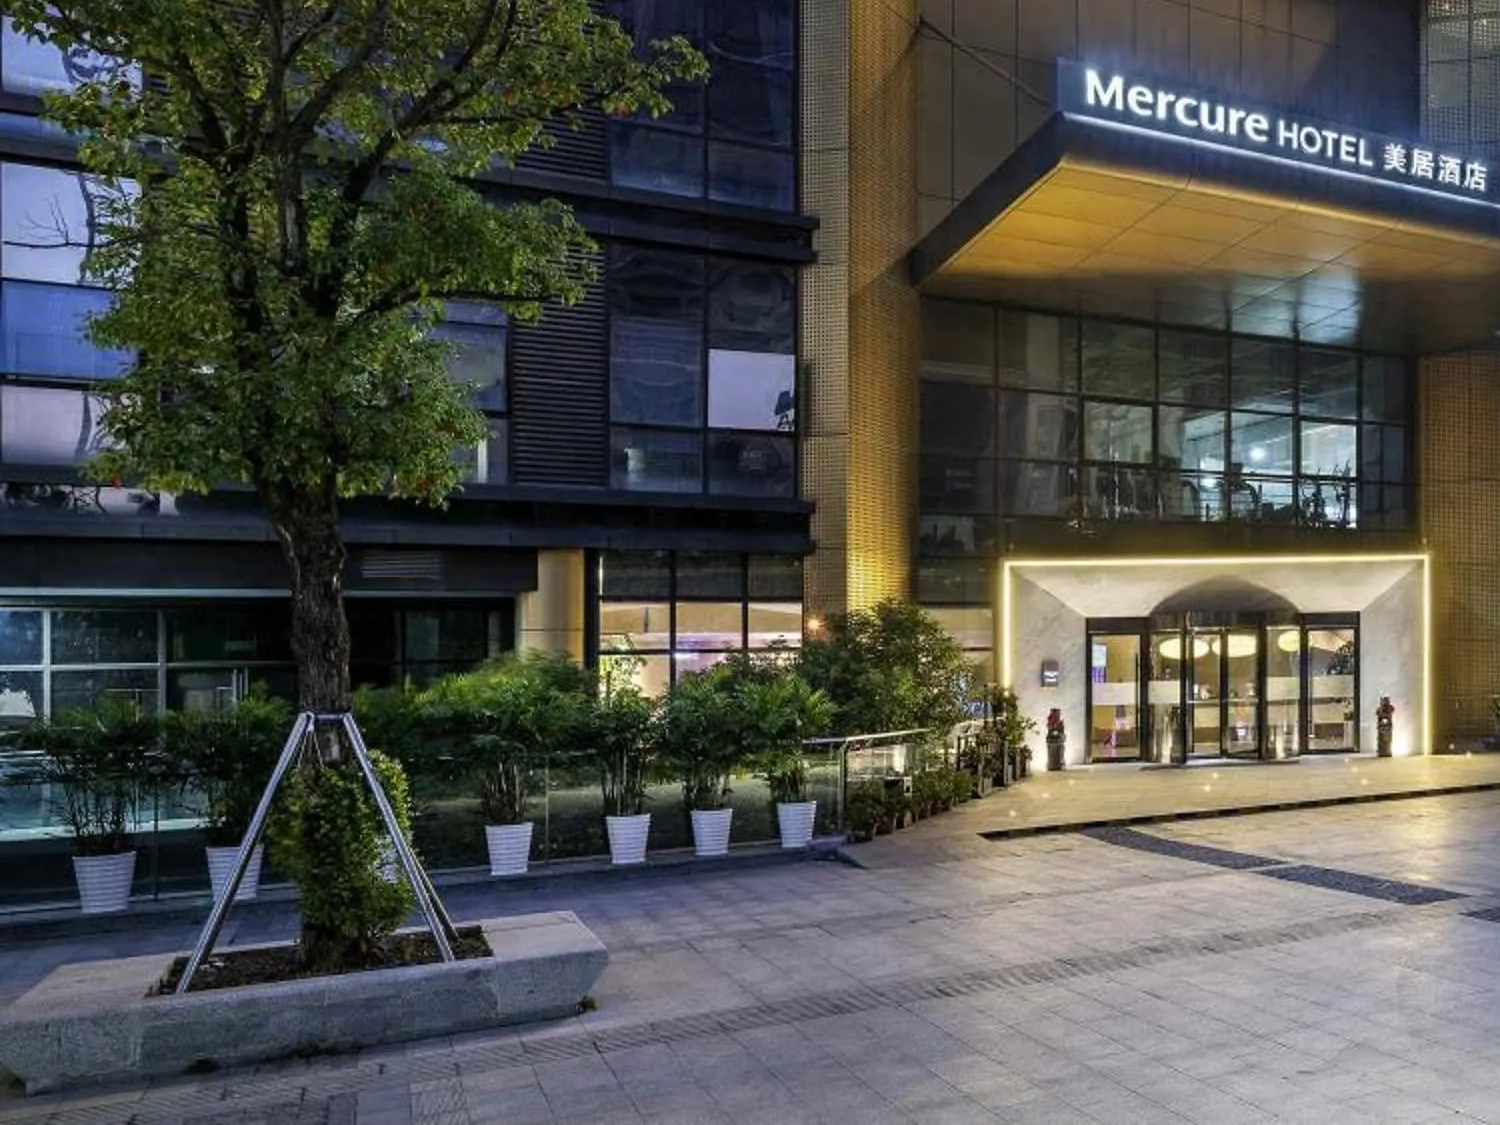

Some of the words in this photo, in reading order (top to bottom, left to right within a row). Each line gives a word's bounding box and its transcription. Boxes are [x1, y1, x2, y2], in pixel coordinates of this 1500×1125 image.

[1085, 68, 1269, 142] Mercure
[1277, 119, 1375, 168] HOTEL
[1383, 142, 1488, 192] 美居酒店
